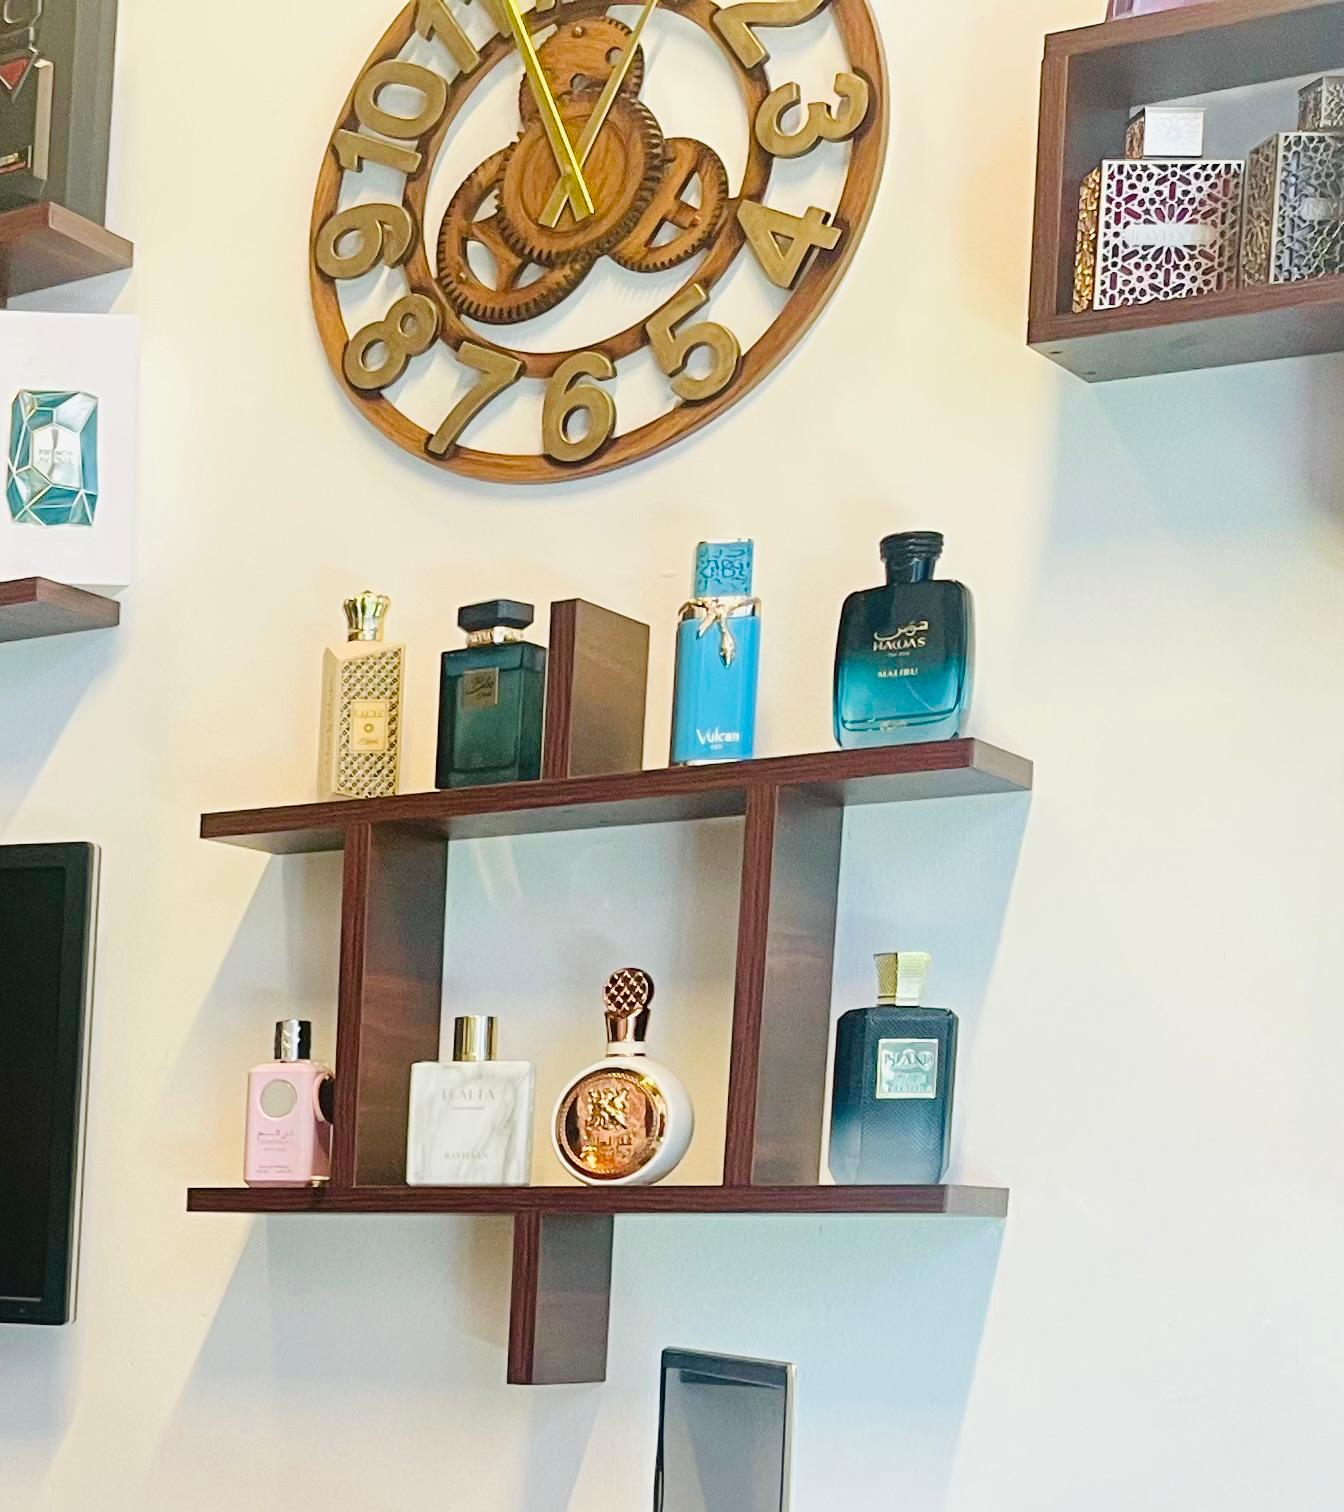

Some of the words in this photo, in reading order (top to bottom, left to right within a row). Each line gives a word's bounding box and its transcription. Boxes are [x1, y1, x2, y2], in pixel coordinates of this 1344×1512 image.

[333, 58, 447, 173] 10
[757, 71, 871, 159] 3
[316, 204, 413, 281] 9
[737, 199, 842, 289] 4
[344, 293, 441, 390] 8
[646, 283, 742, 401] 5
[427, 340, 526, 457] 7
[542, 350, 617, 463] 6
